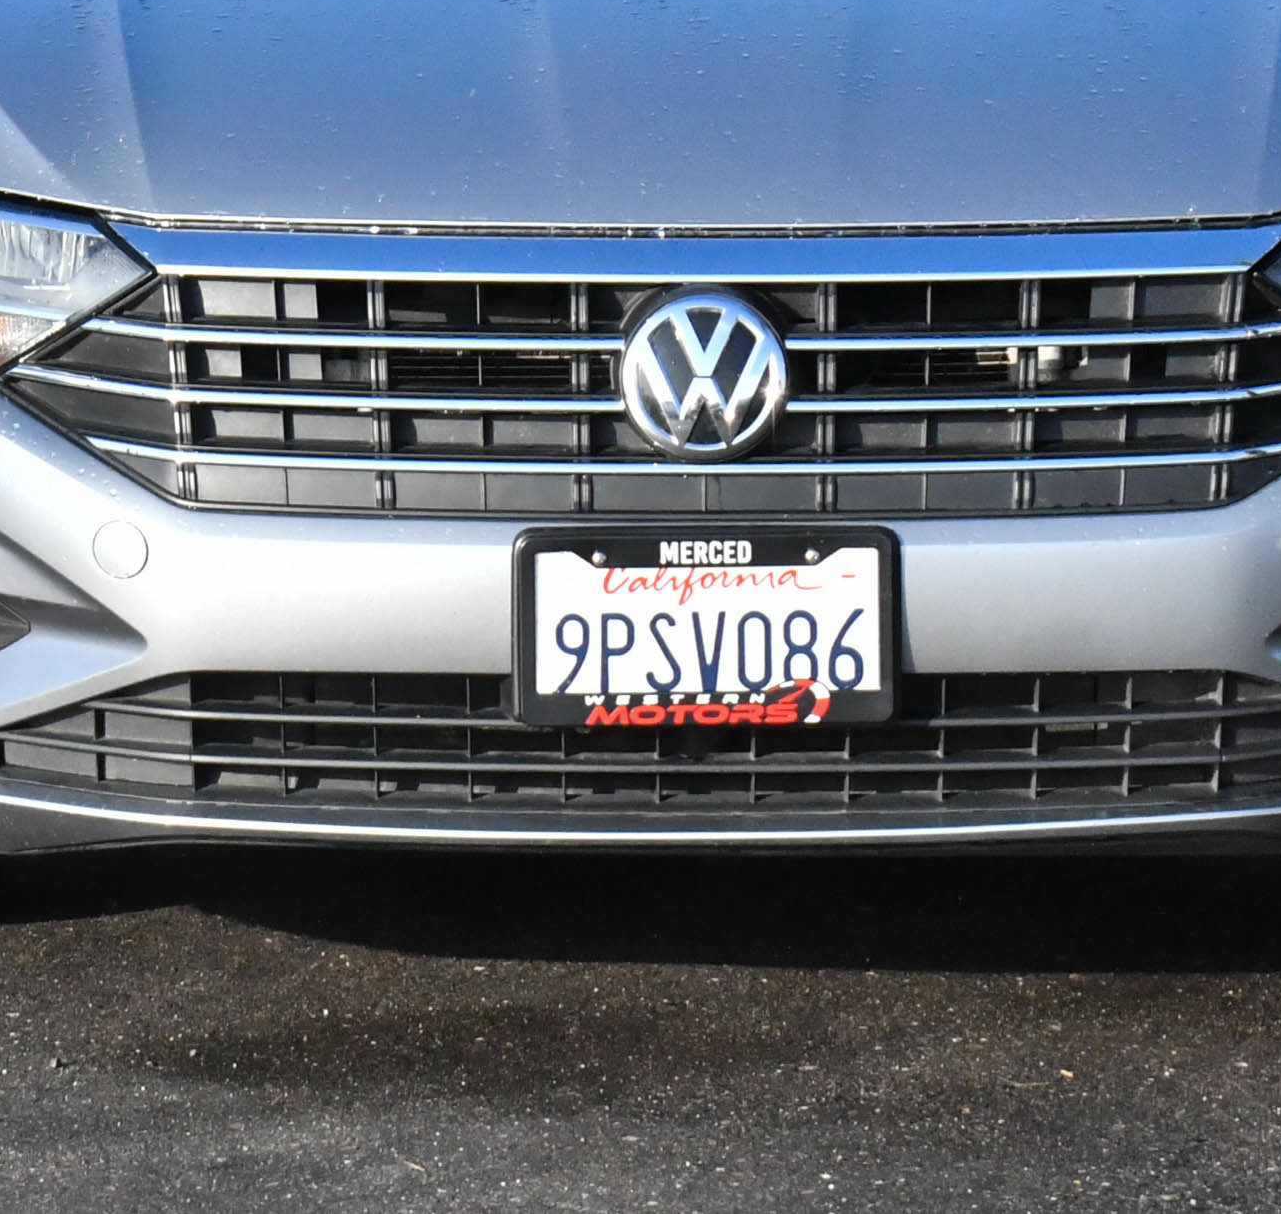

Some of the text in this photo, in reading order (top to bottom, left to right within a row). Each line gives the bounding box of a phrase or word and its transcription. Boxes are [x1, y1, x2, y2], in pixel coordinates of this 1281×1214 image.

[659, 539, 753, 565] MERCED
[602, 566, 823, 606] California
[554, 607, 865, 695] 9PSV086
[584, 693, 767, 706] WESTERN
[585, 702, 799, 727] MOTORS
